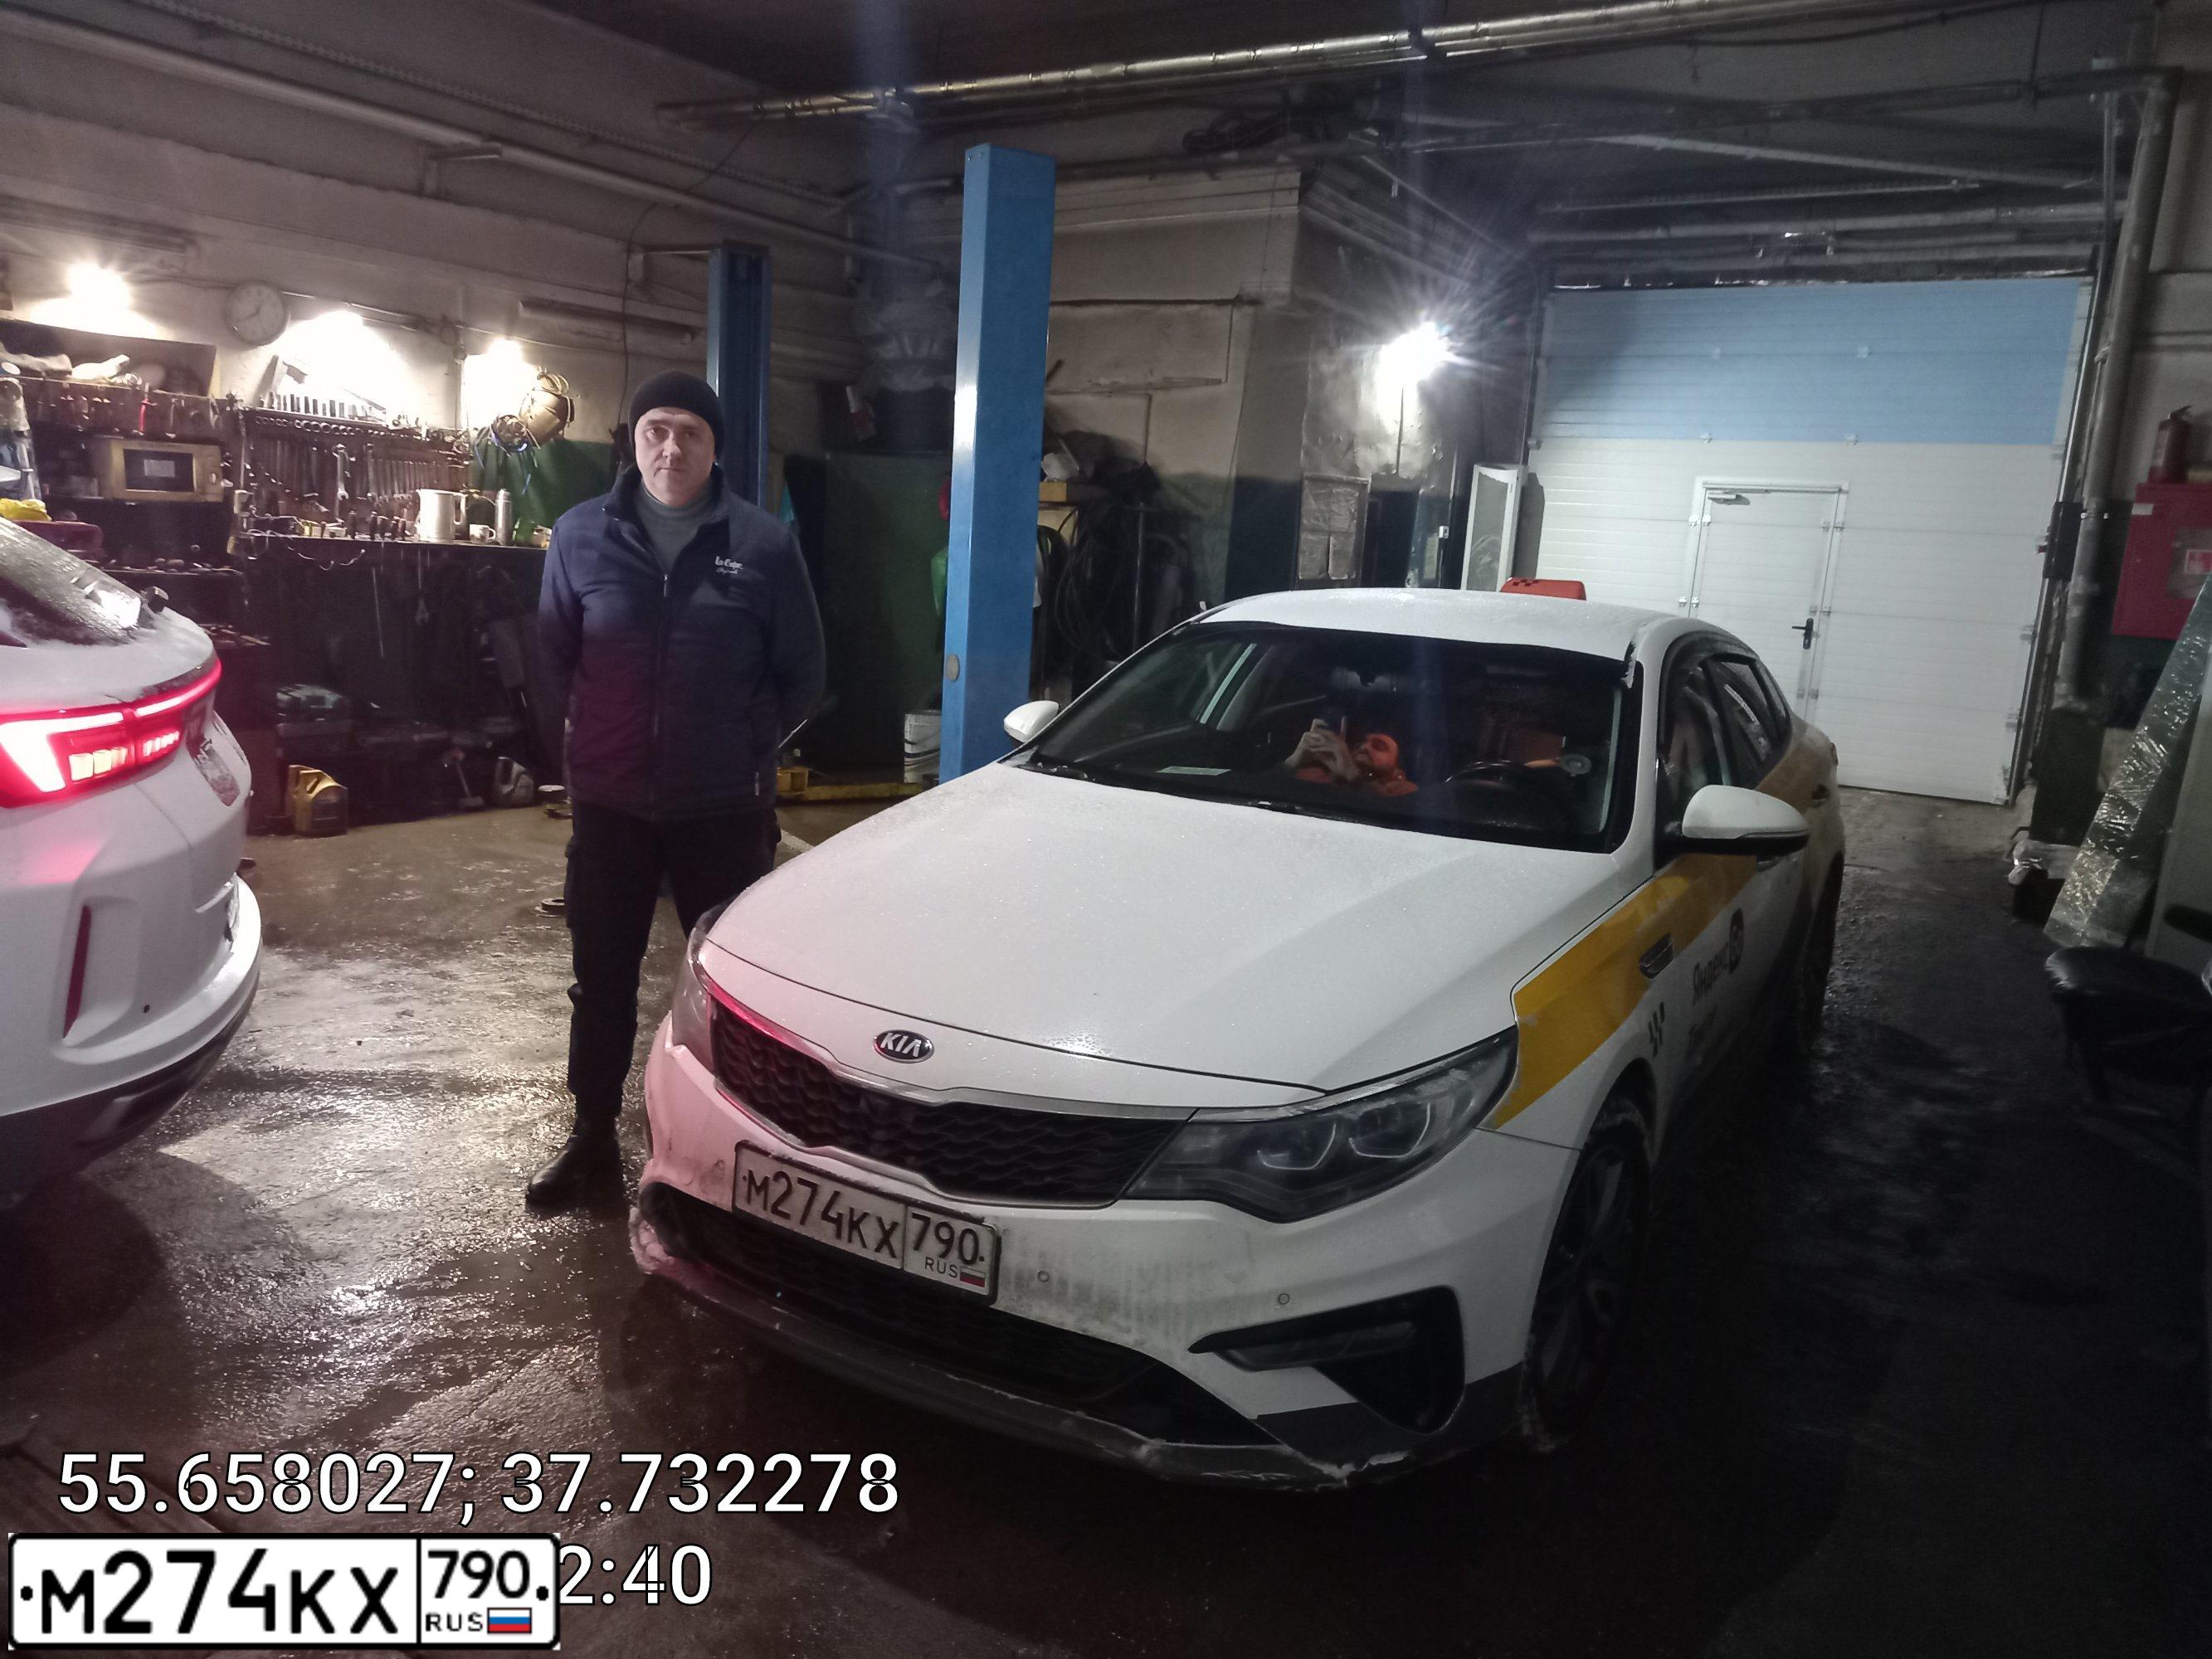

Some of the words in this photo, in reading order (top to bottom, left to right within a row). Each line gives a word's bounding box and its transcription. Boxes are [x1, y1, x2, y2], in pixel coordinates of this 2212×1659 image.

[879, 1032, 922, 1058] KIA
[911, 1212, 981, 1266] 790
[924, 1257, 958, 1278] RUS
